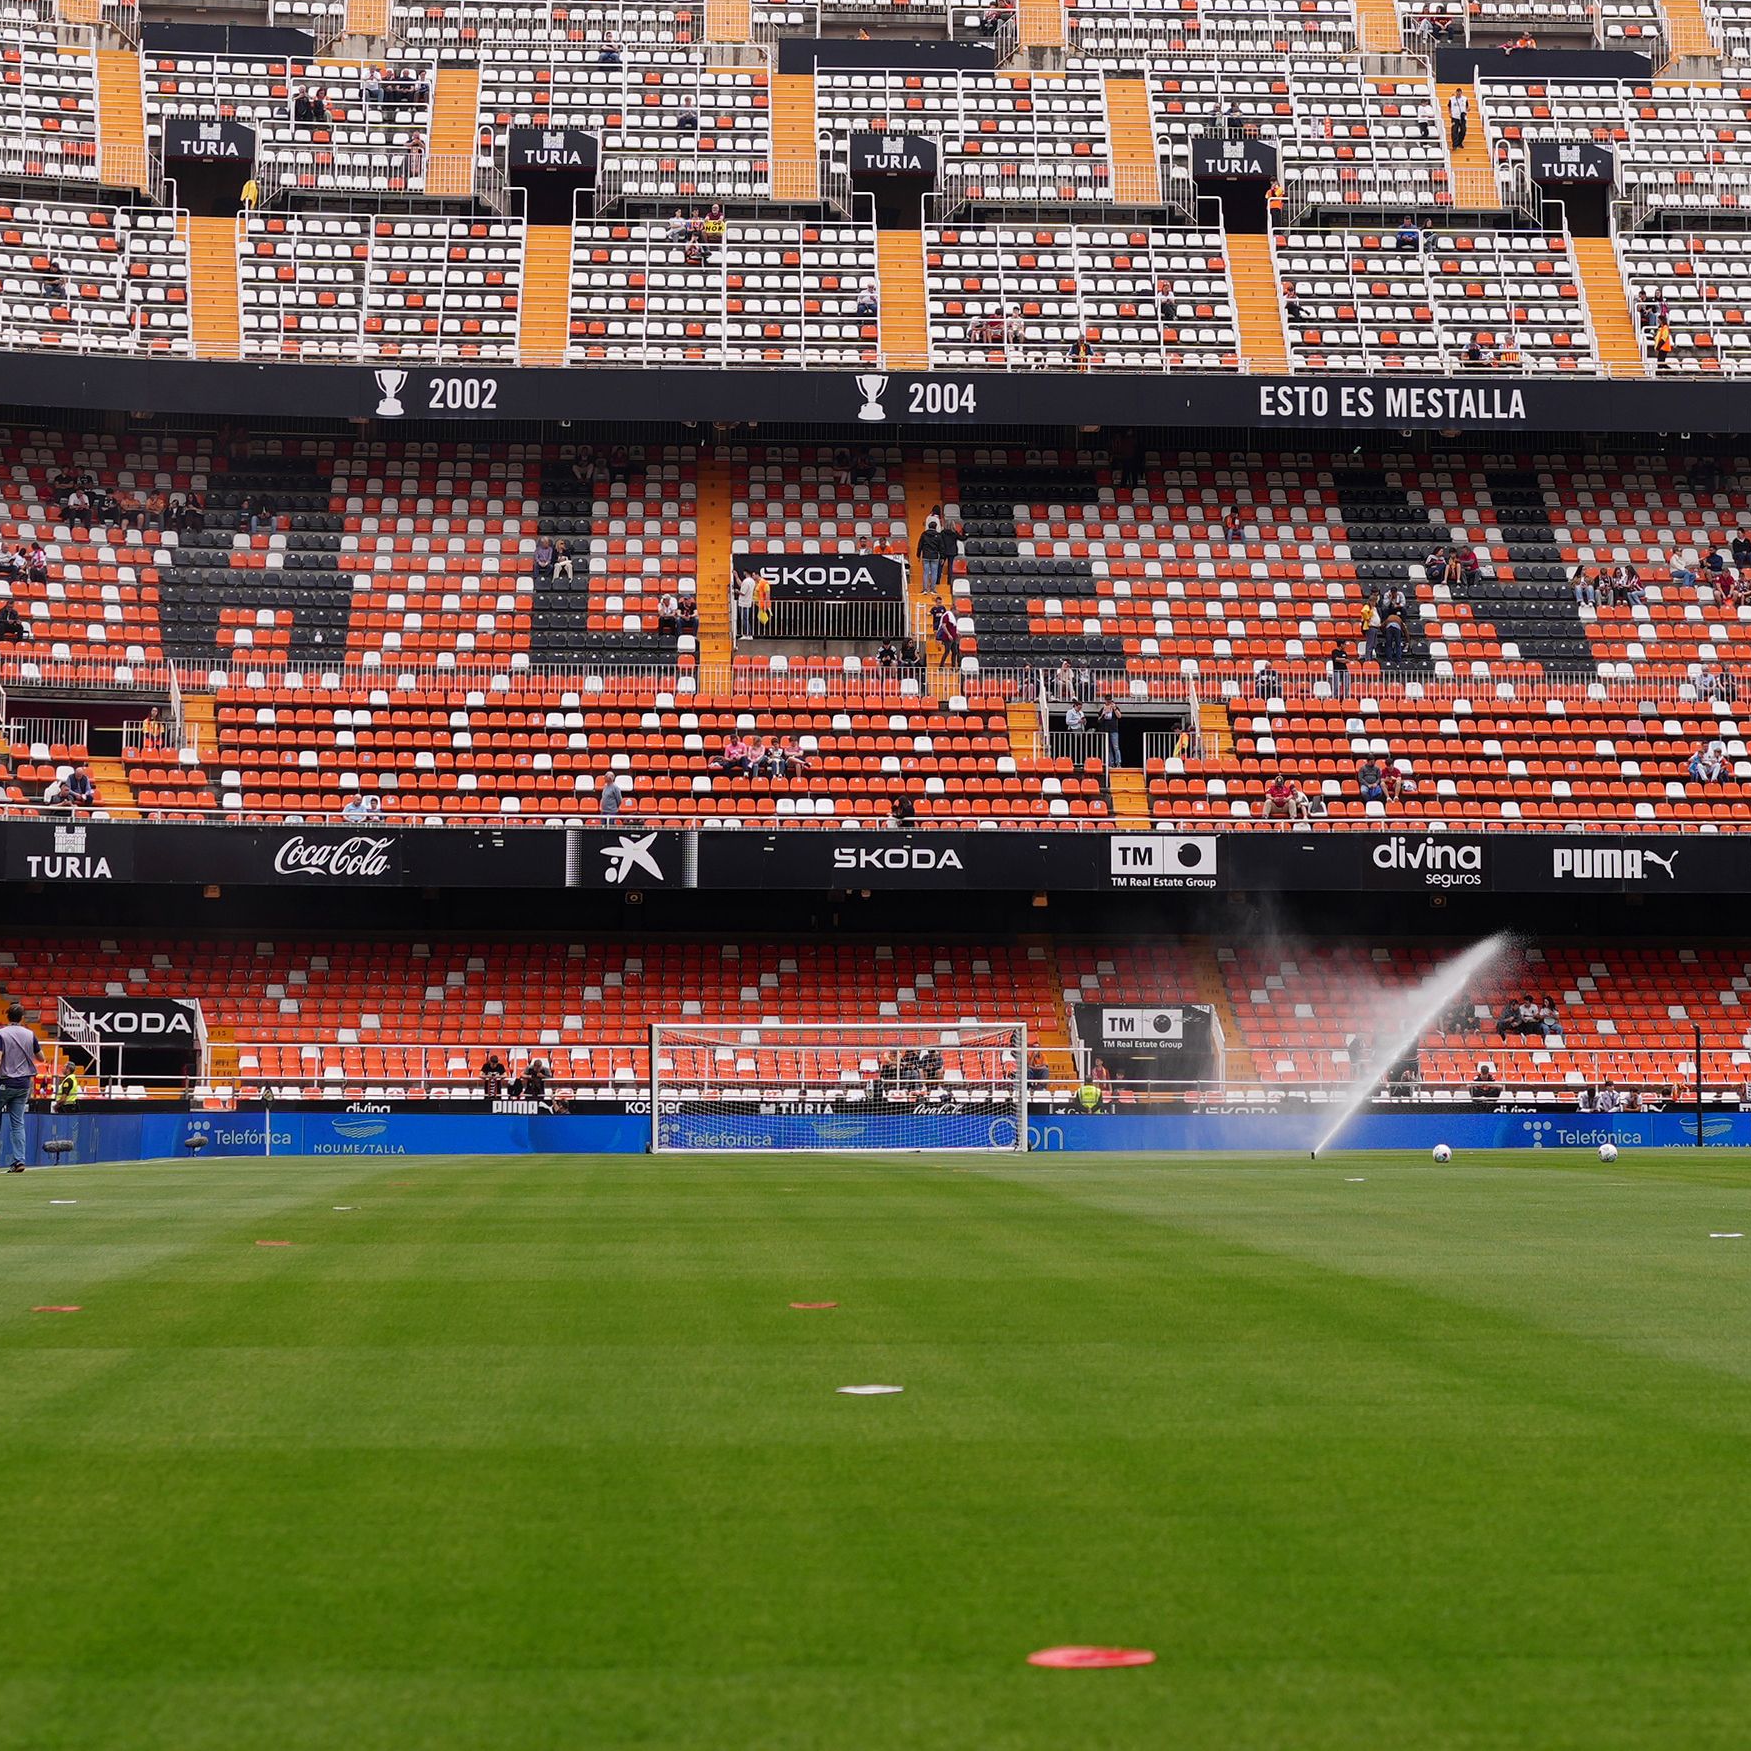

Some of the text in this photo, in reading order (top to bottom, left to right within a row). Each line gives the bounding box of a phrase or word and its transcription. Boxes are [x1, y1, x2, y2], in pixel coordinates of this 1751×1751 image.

[180, 140, 239, 156] TURIA
[524, 149, 582, 166] TURIA
[864, 154, 922, 169] TURIA
[1205, 158, 1263, 174] TURIA
[1542, 163, 1599, 178] TURIA
[429, 378, 498, 409] 2002
[908, 383, 977, 413] 2004
[1260, 384, 1526, 420] ESTO ES MESTALLA
[274, 835, 395, 876] Coca-Cola
[833, 848, 963, 869] SKODA
[1118, 845, 1153, 866] TM
[1372, 836, 1482, 870] divina
[26, 856, 112, 879] TURIA
[1553, 848, 1643, 879] PUMA
[1111, 876, 1217, 890] TM Real Estate Group
[1425, 873, 1482, 888] seguros
[1108, 1017, 1135, 1032] TM
[1102, 1040, 1183, 1051] TM Real Estate Group
[346, 1100, 391, 1114] divina
[491, 1100, 539, 1114] PUMA
[779, 1103, 834, 1115] TURIA
[214, 1128, 292, 1146] Telefónica
[685, 1130, 772, 1148] Telefónica
[1556, 1127, 1643, 1146] Telefónica
